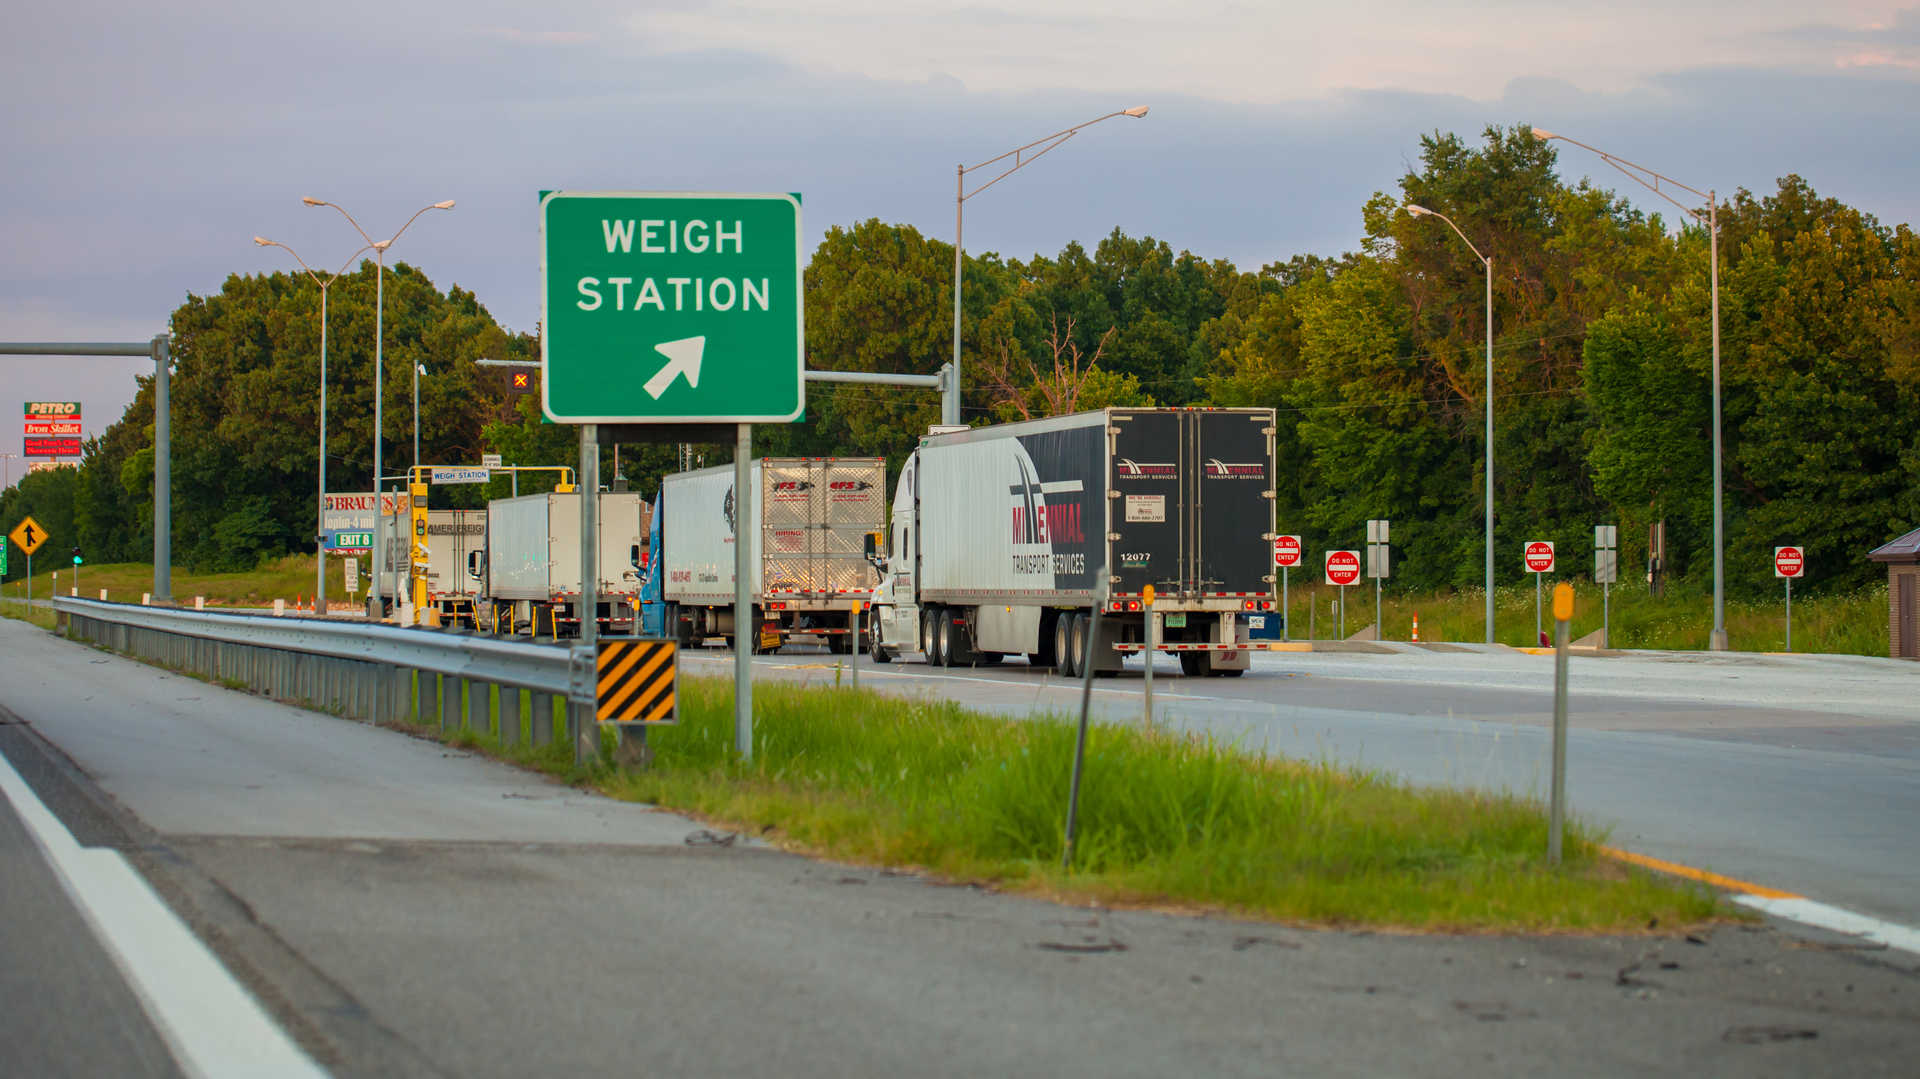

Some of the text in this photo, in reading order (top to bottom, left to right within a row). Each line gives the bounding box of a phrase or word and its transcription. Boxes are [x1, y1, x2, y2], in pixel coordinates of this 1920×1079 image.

[602, 219, 742, 253] WEIGH
[576, 277, 769, 311] STATION
[30, 403, 76, 414] PETRO
[27, 424, 79, 433] Iron Skillet
[340, 534, 370, 545] EXIT 8
[1013, 553, 1084, 574] TRANSPORT SERVICES
